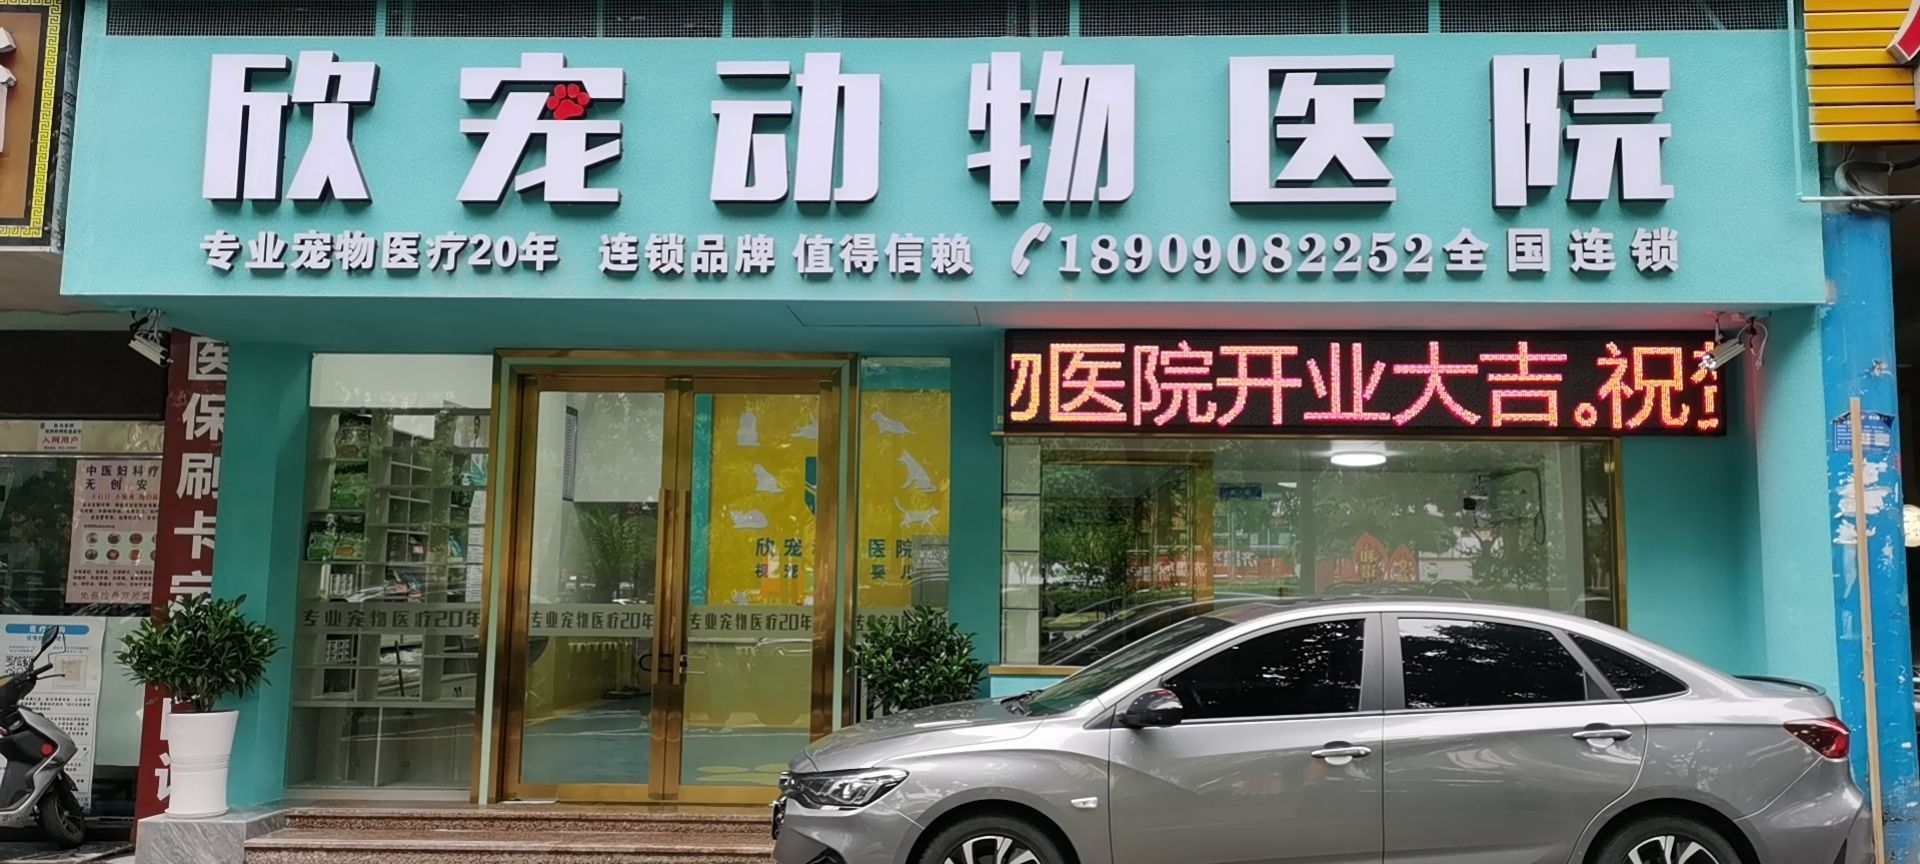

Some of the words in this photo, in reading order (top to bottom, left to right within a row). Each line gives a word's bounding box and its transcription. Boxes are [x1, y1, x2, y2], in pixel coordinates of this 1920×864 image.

[202, 44, 1674, 208] 欣宠动物医院
[199, 230, 560, 272] 专业宠物医疗20年
[598, 232, 777, 275] 连锁品牌
[793, 233, 974, 275] 值得信赖
[1059, 231, 1434, 274] 18909082252
[1443, 226, 1681, 273] 全国连锁
[1010, 341, 1719, 430] 医院开业大吉。祝
[755, 537, 816, 558] 欣宠
[303, 609, 480, 628] 专业宠物医疗20年
[530, 610, 654, 630] 专业宠物医疗20年
[689, 612, 812, 631] 专业宠物医疗20年
